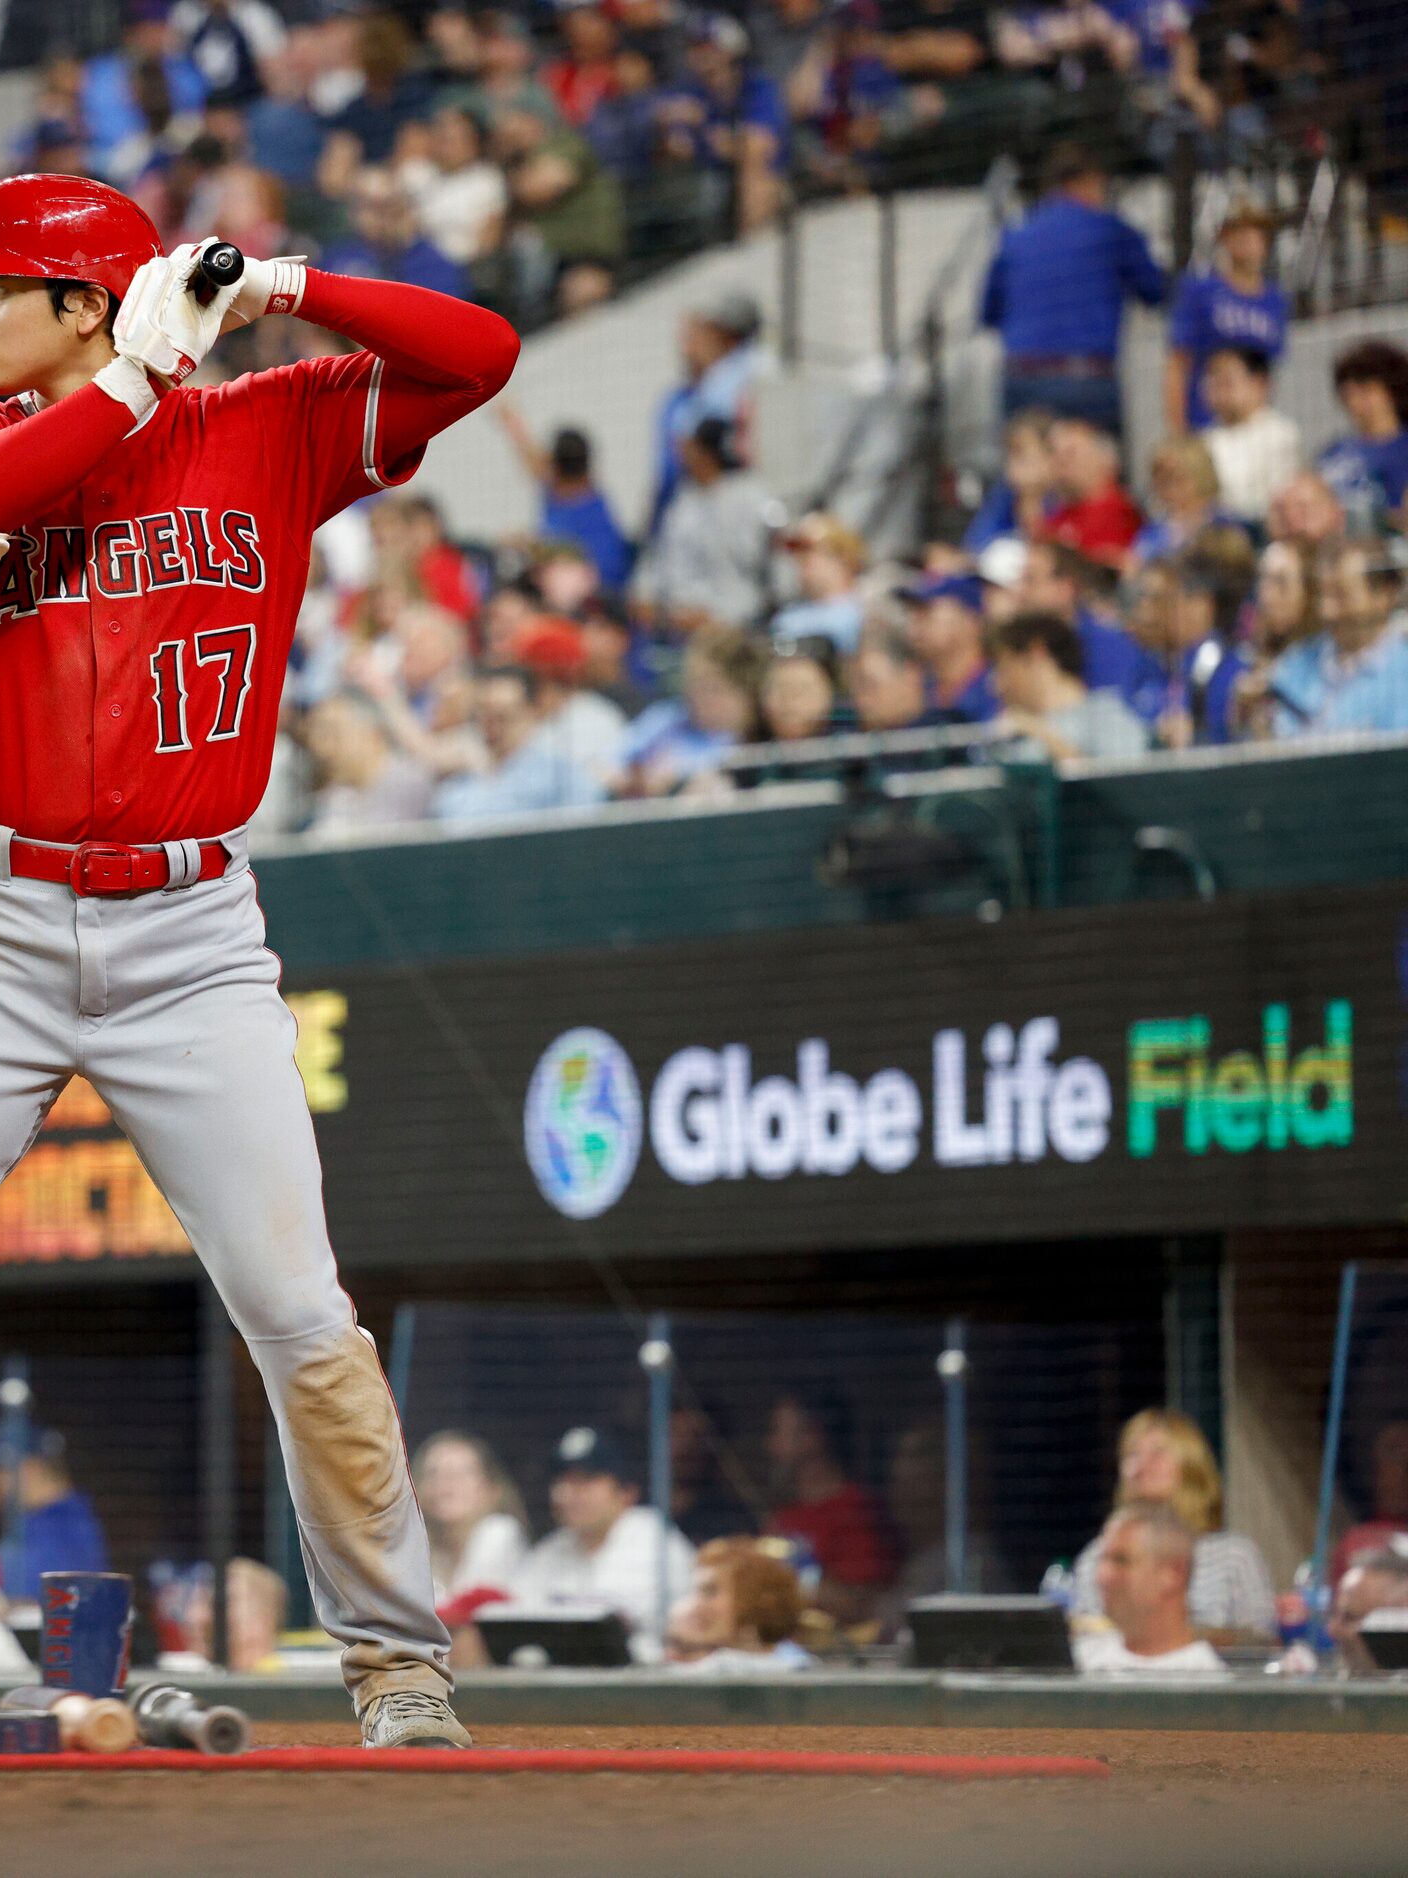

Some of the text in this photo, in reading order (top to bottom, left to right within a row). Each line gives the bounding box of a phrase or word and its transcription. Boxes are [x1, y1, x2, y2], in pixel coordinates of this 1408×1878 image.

[150, 623, 256, 754] 17
[649, 998, 1354, 1186] Globe Life Field
